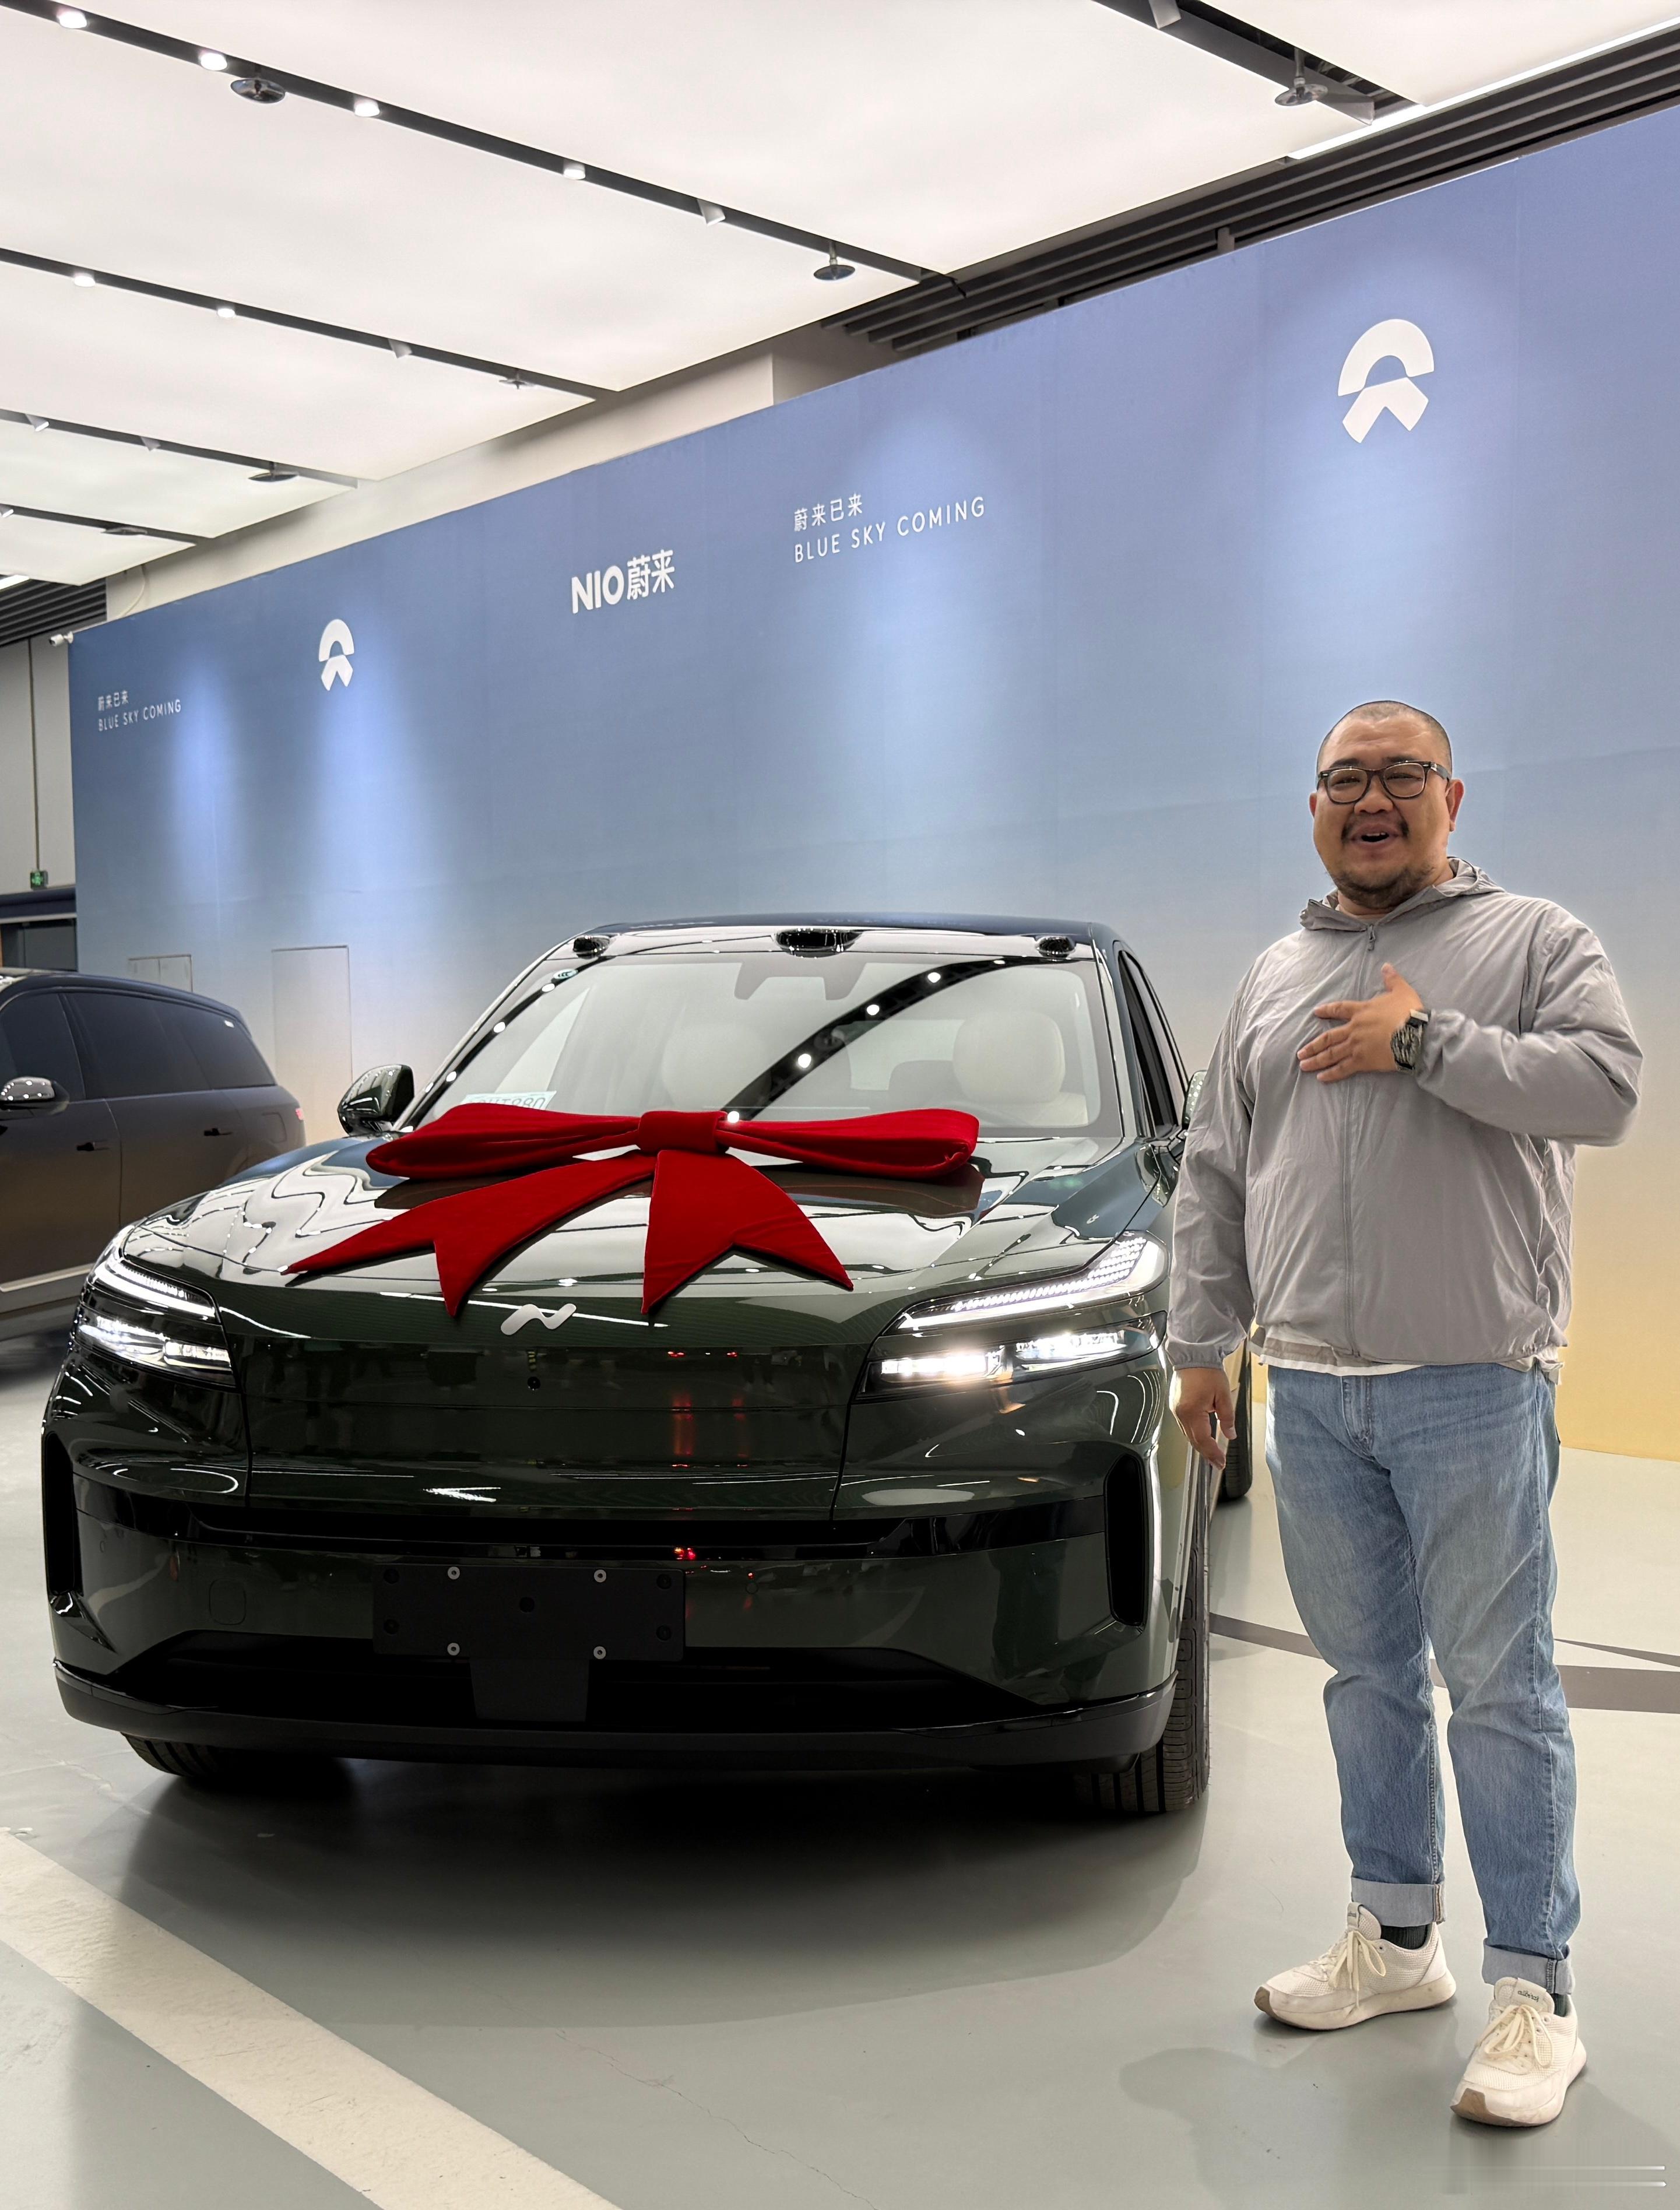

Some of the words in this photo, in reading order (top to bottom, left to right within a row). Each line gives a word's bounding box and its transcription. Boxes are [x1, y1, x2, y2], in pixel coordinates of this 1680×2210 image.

[795, 493, 863, 532] 蔚来已来
[795, 534, 841, 563] BLUE
[851, 522, 886, 549] SKY
[897, 496, 985, 536] COMING
[98, 714, 120, 732] BLUE
[122, 709, 139, 726] SKY
[143, 698, 181, 721] COMING
